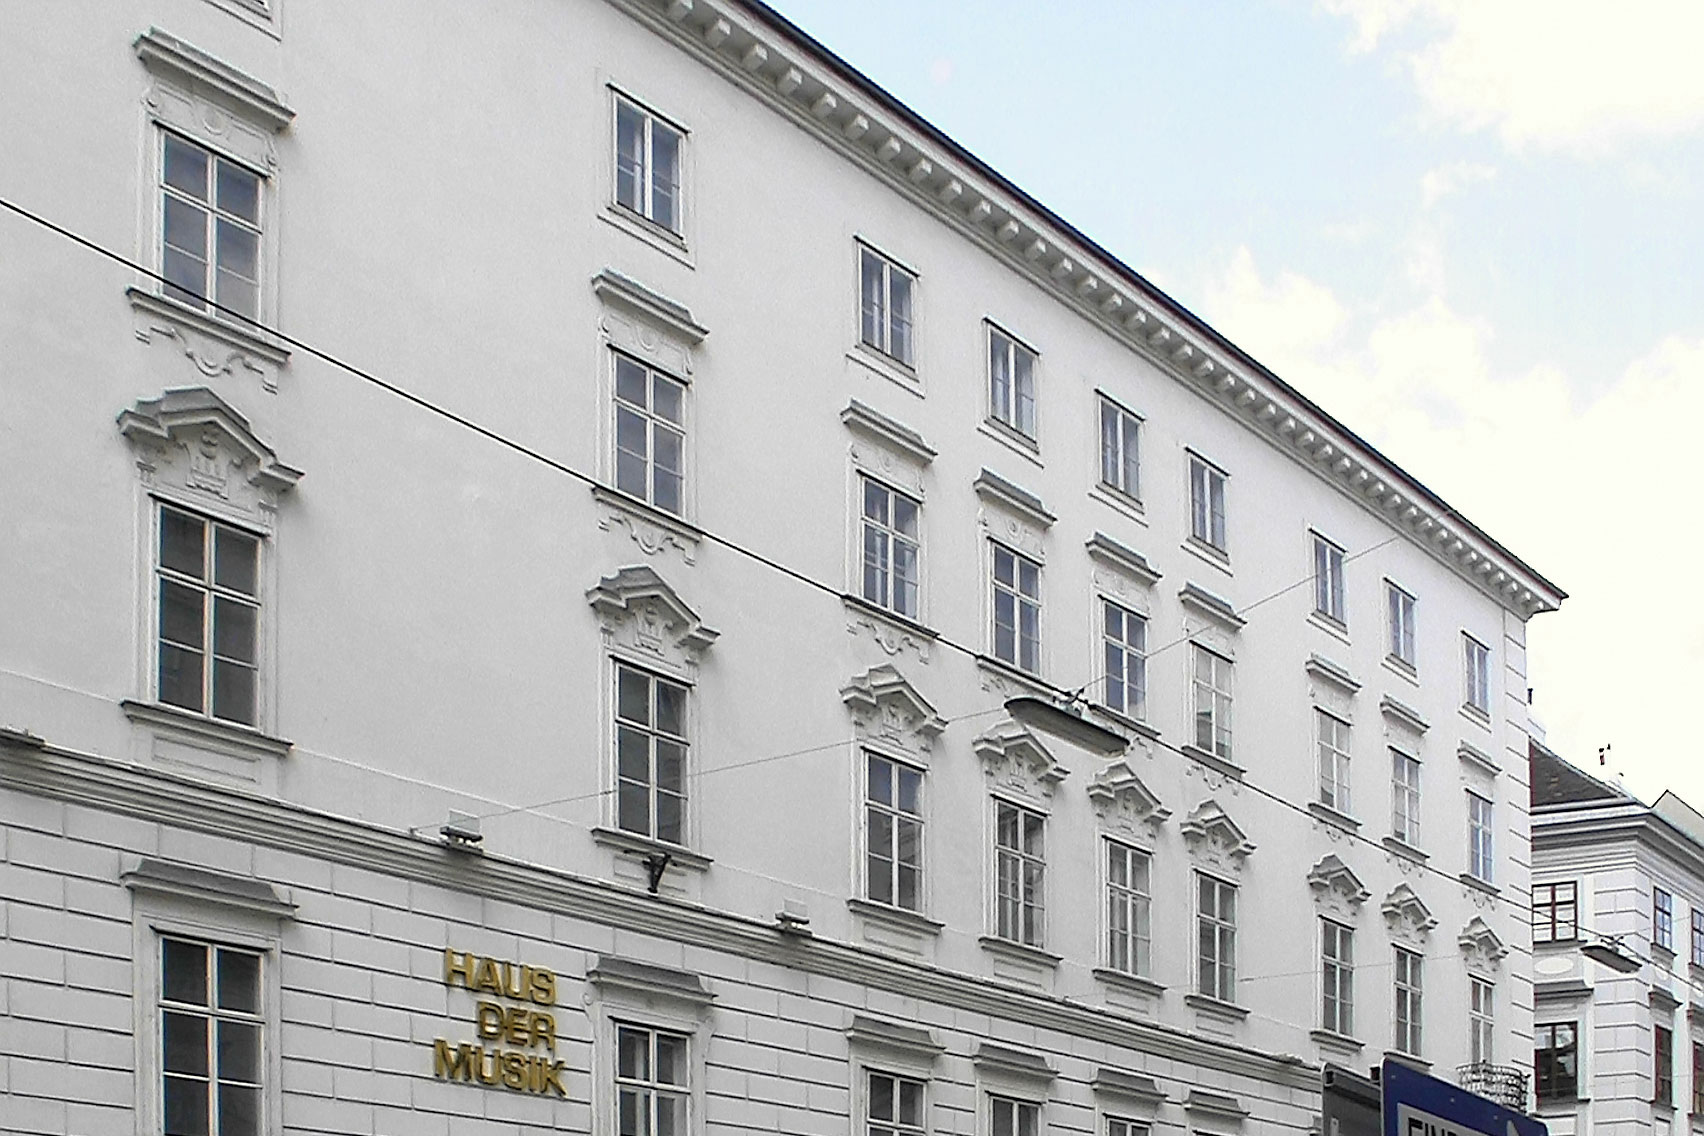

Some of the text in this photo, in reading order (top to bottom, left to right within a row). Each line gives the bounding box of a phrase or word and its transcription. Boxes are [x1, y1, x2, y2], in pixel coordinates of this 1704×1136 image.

[444, 947, 557, 1006] HAUS
[477, 1001, 556, 1053] DER
[433, 1037, 567, 1097] MUSIK
